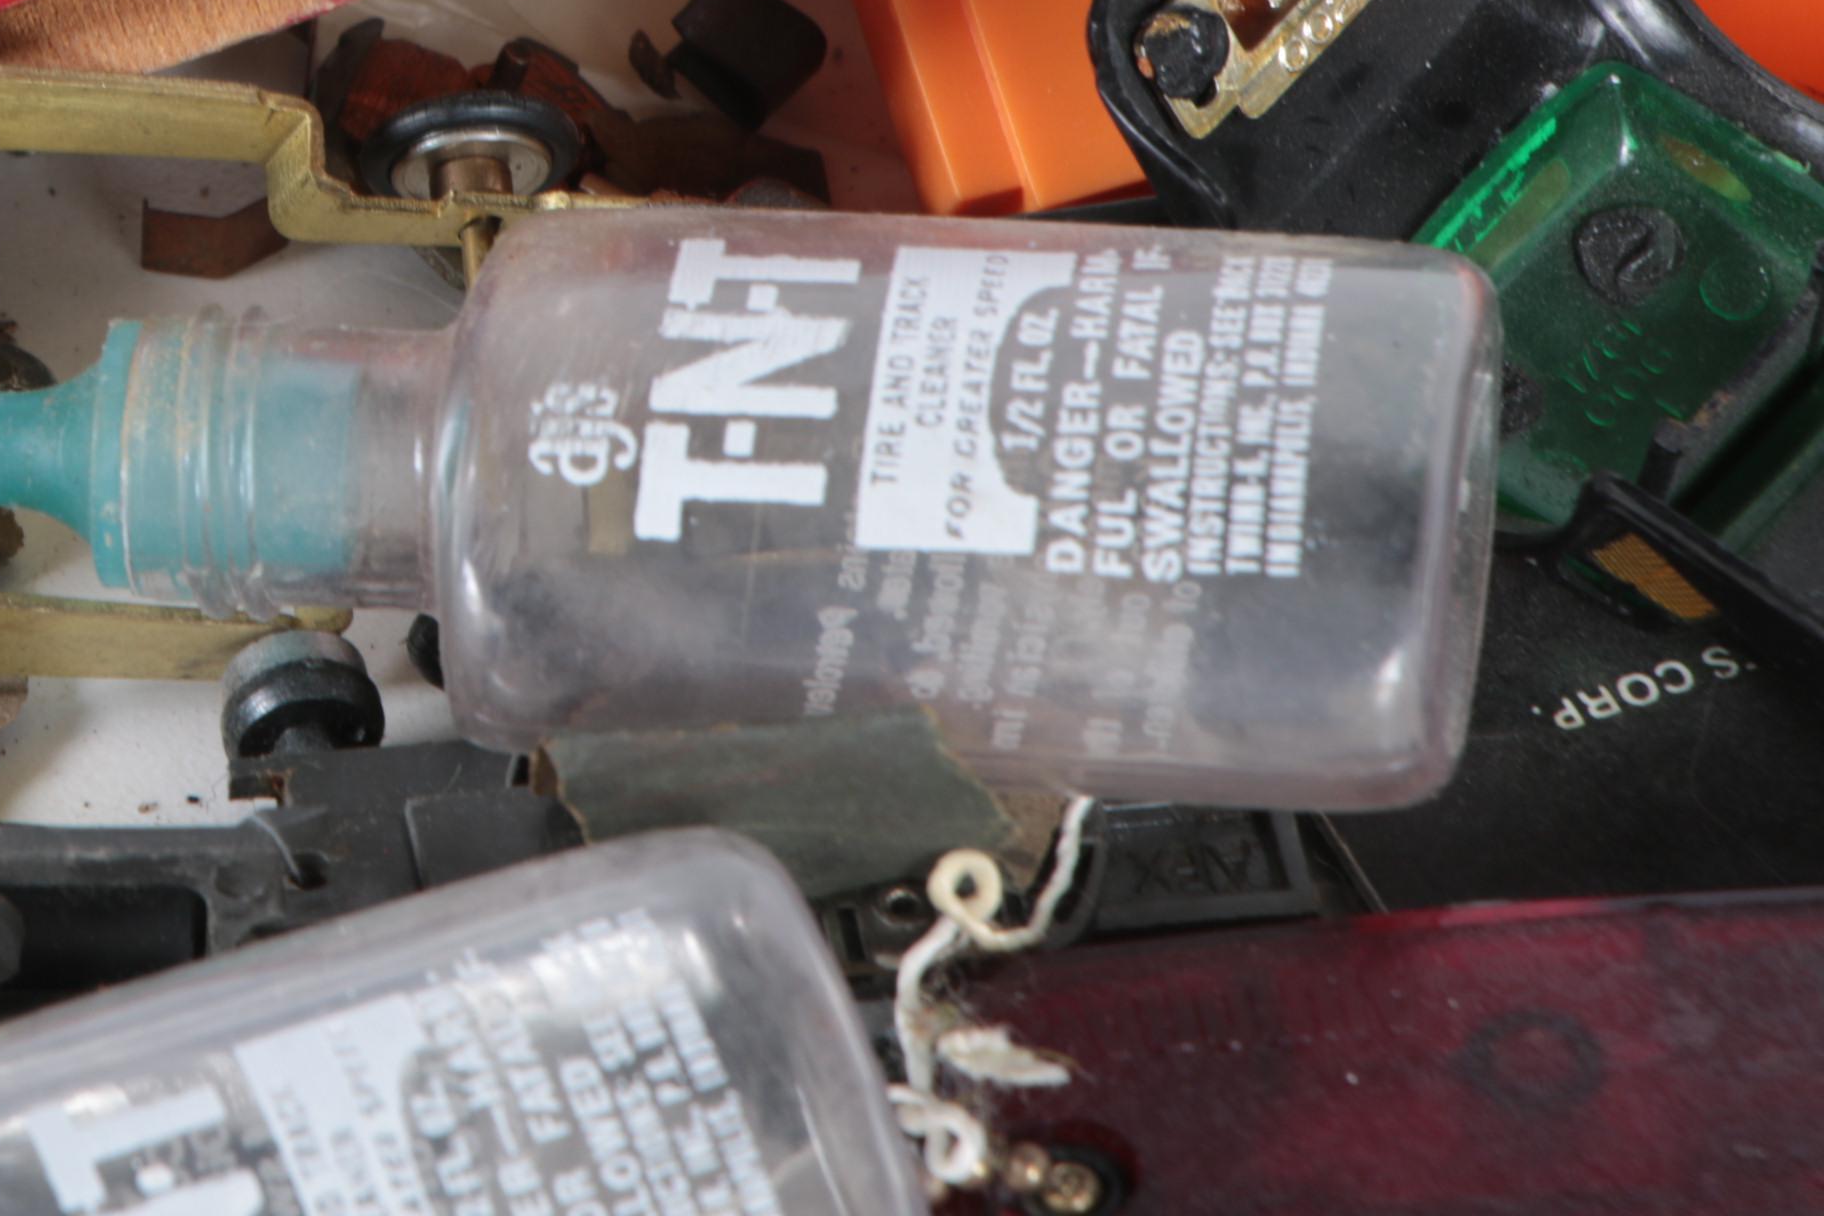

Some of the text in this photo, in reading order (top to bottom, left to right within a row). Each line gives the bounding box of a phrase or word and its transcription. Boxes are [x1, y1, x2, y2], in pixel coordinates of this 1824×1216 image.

[870, 276, 928, 484] TIRE AND TRACK
[915, 316, 956, 428] CLEANER
[1113, 285, 1164, 380] FATAL
[634, 237, 862, 543] T-N-T
[945, 254, 1009, 540] FOR GREATER SPEED
[1000, 396, 1046, 452] 1/2
[1103, 404, 1146, 462] OR
[1141, 329, 1205, 582] SWALLOWED
[1092, 487, 1137, 579] FUL
[1530, 659, 1695, 731] CORP.
[1124, 839, 1252, 895] AFX
